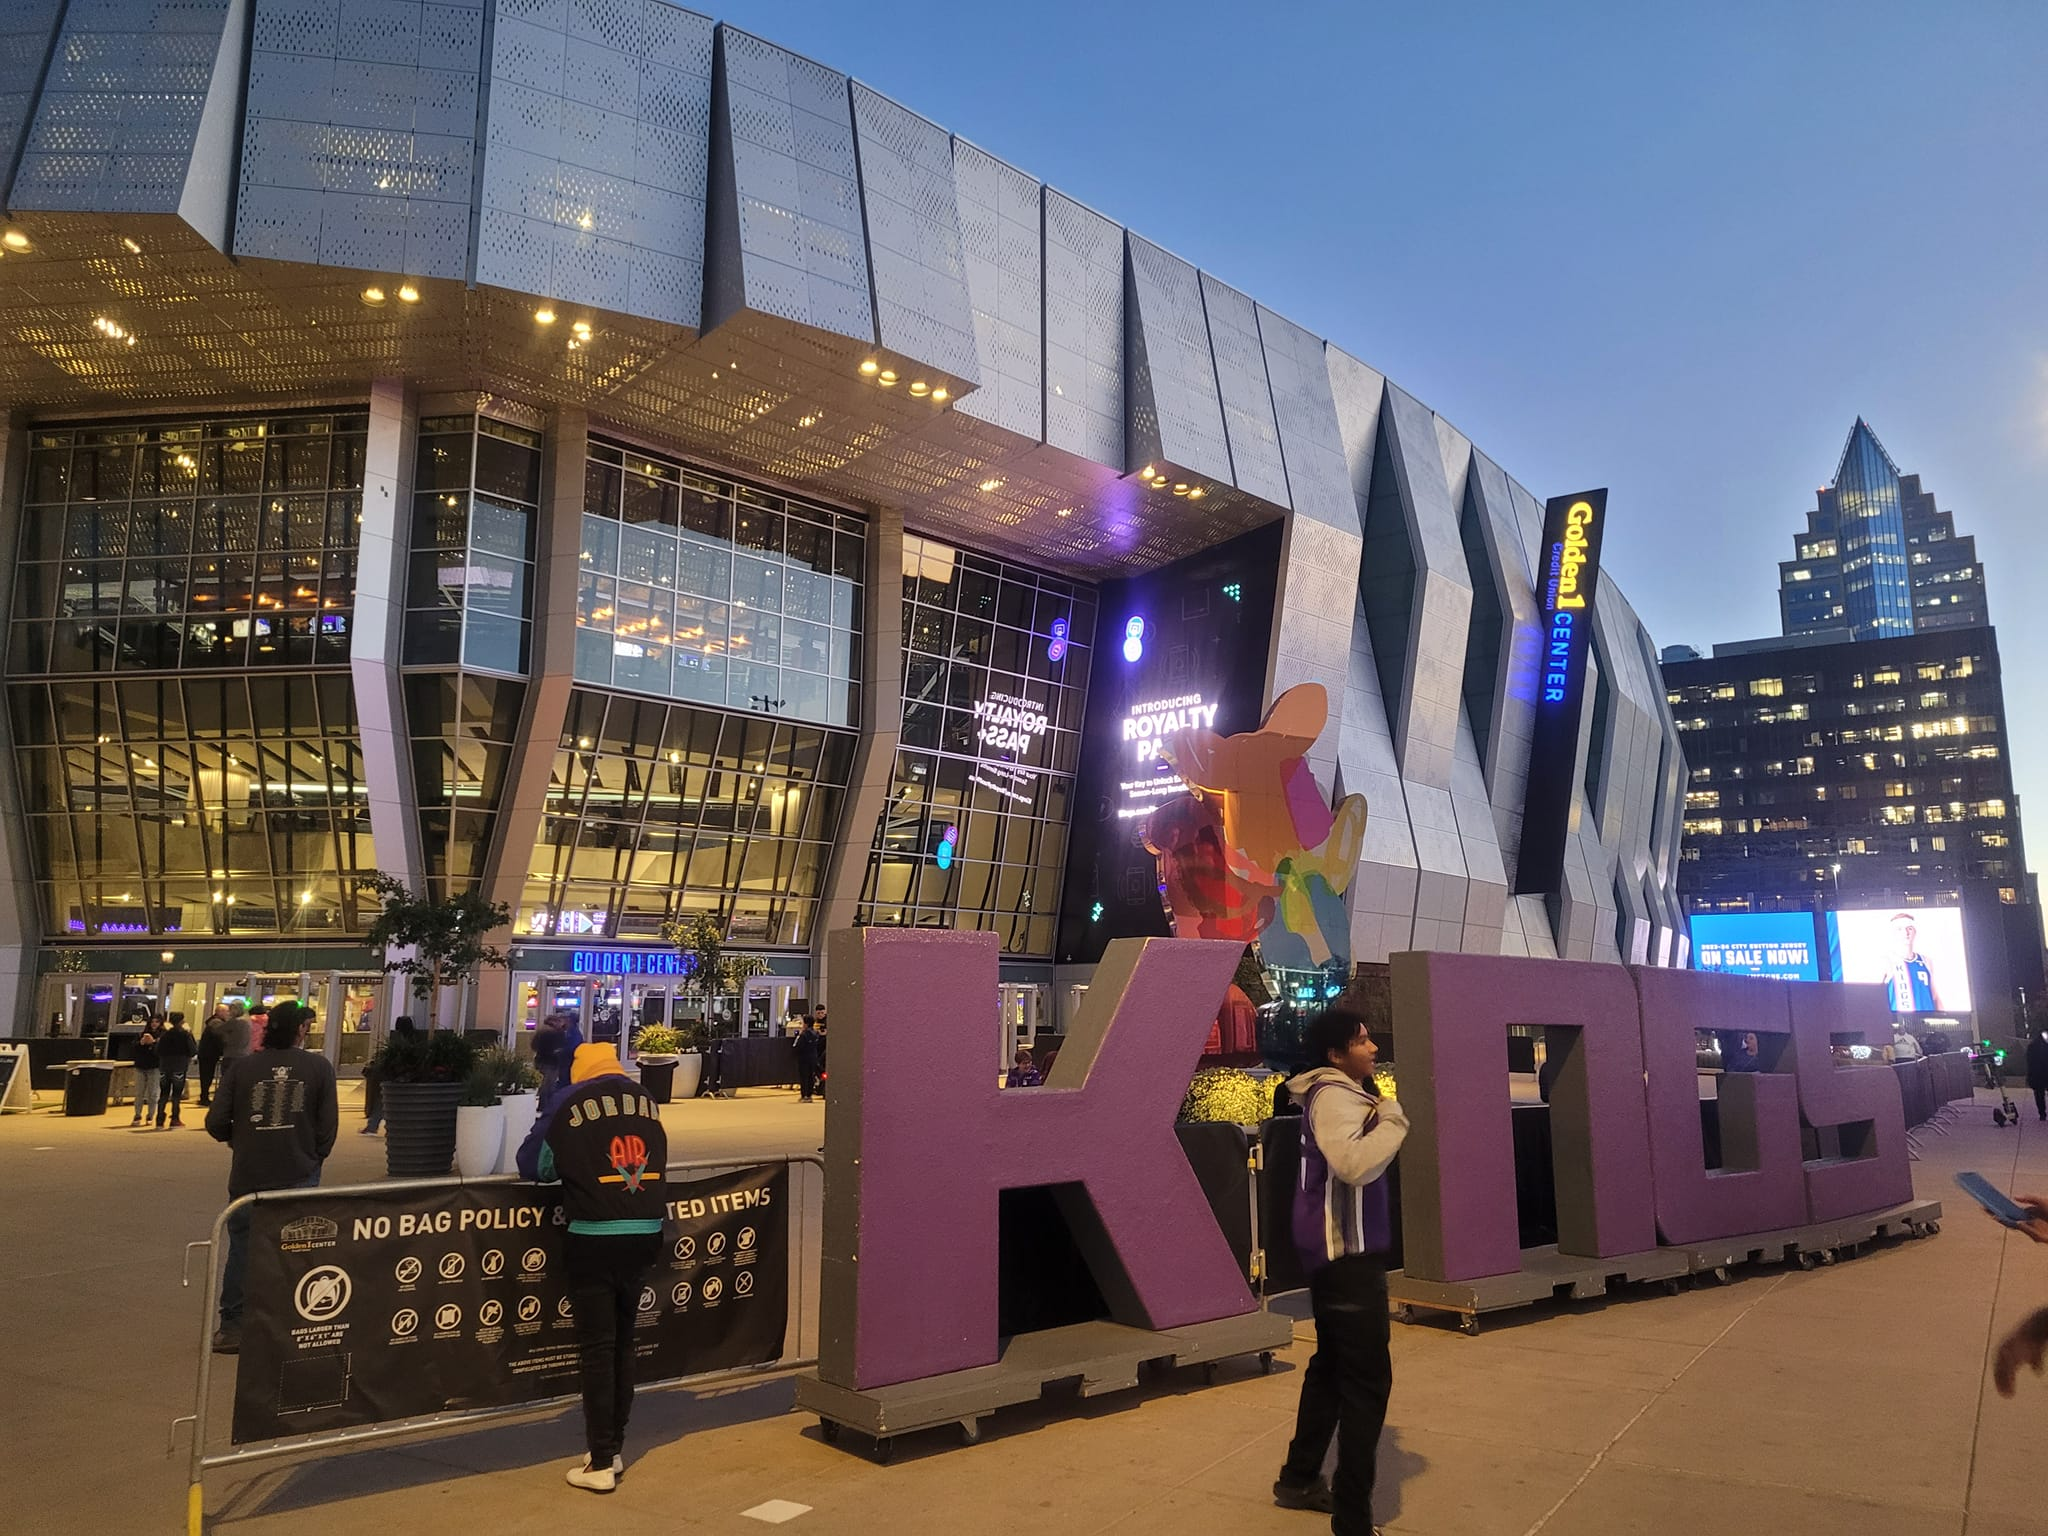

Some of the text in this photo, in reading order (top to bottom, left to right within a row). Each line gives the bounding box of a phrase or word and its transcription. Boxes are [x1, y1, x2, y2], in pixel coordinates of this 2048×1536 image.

[1545, 542, 1562, 610] Credit Union
[1545, 611, 1575, 702] CENTER
[1132, 693, 1201, 715] INTRODUCING
[1123, 704, 1218, 741] ROYALTY
[1701, 949, 1809, 965] ON SALE NOW!
[1780, 942, 1807, 950] JERSEY
[573, 951, 631, 974] GOLDEN
[636, 954, 642, 974] 1
[1917, 971, 1929, 986] 9
[609, 1135, 648, 1169] AIR
[352, 1216, 391, 1241] NO
[399, 1211, 452, 1237] BAG
[459, 1205, 545, 1232] POLICY
[552, 1205, 568, 1226] &
[710, 1187, 771, 1214] ITEMS
[312, 1241, 336, 1249] CENTER
[291, 1322, 350, 1336] BAGS LARGER THAN
[312, 1339, 341, 1348] ALLOWED
